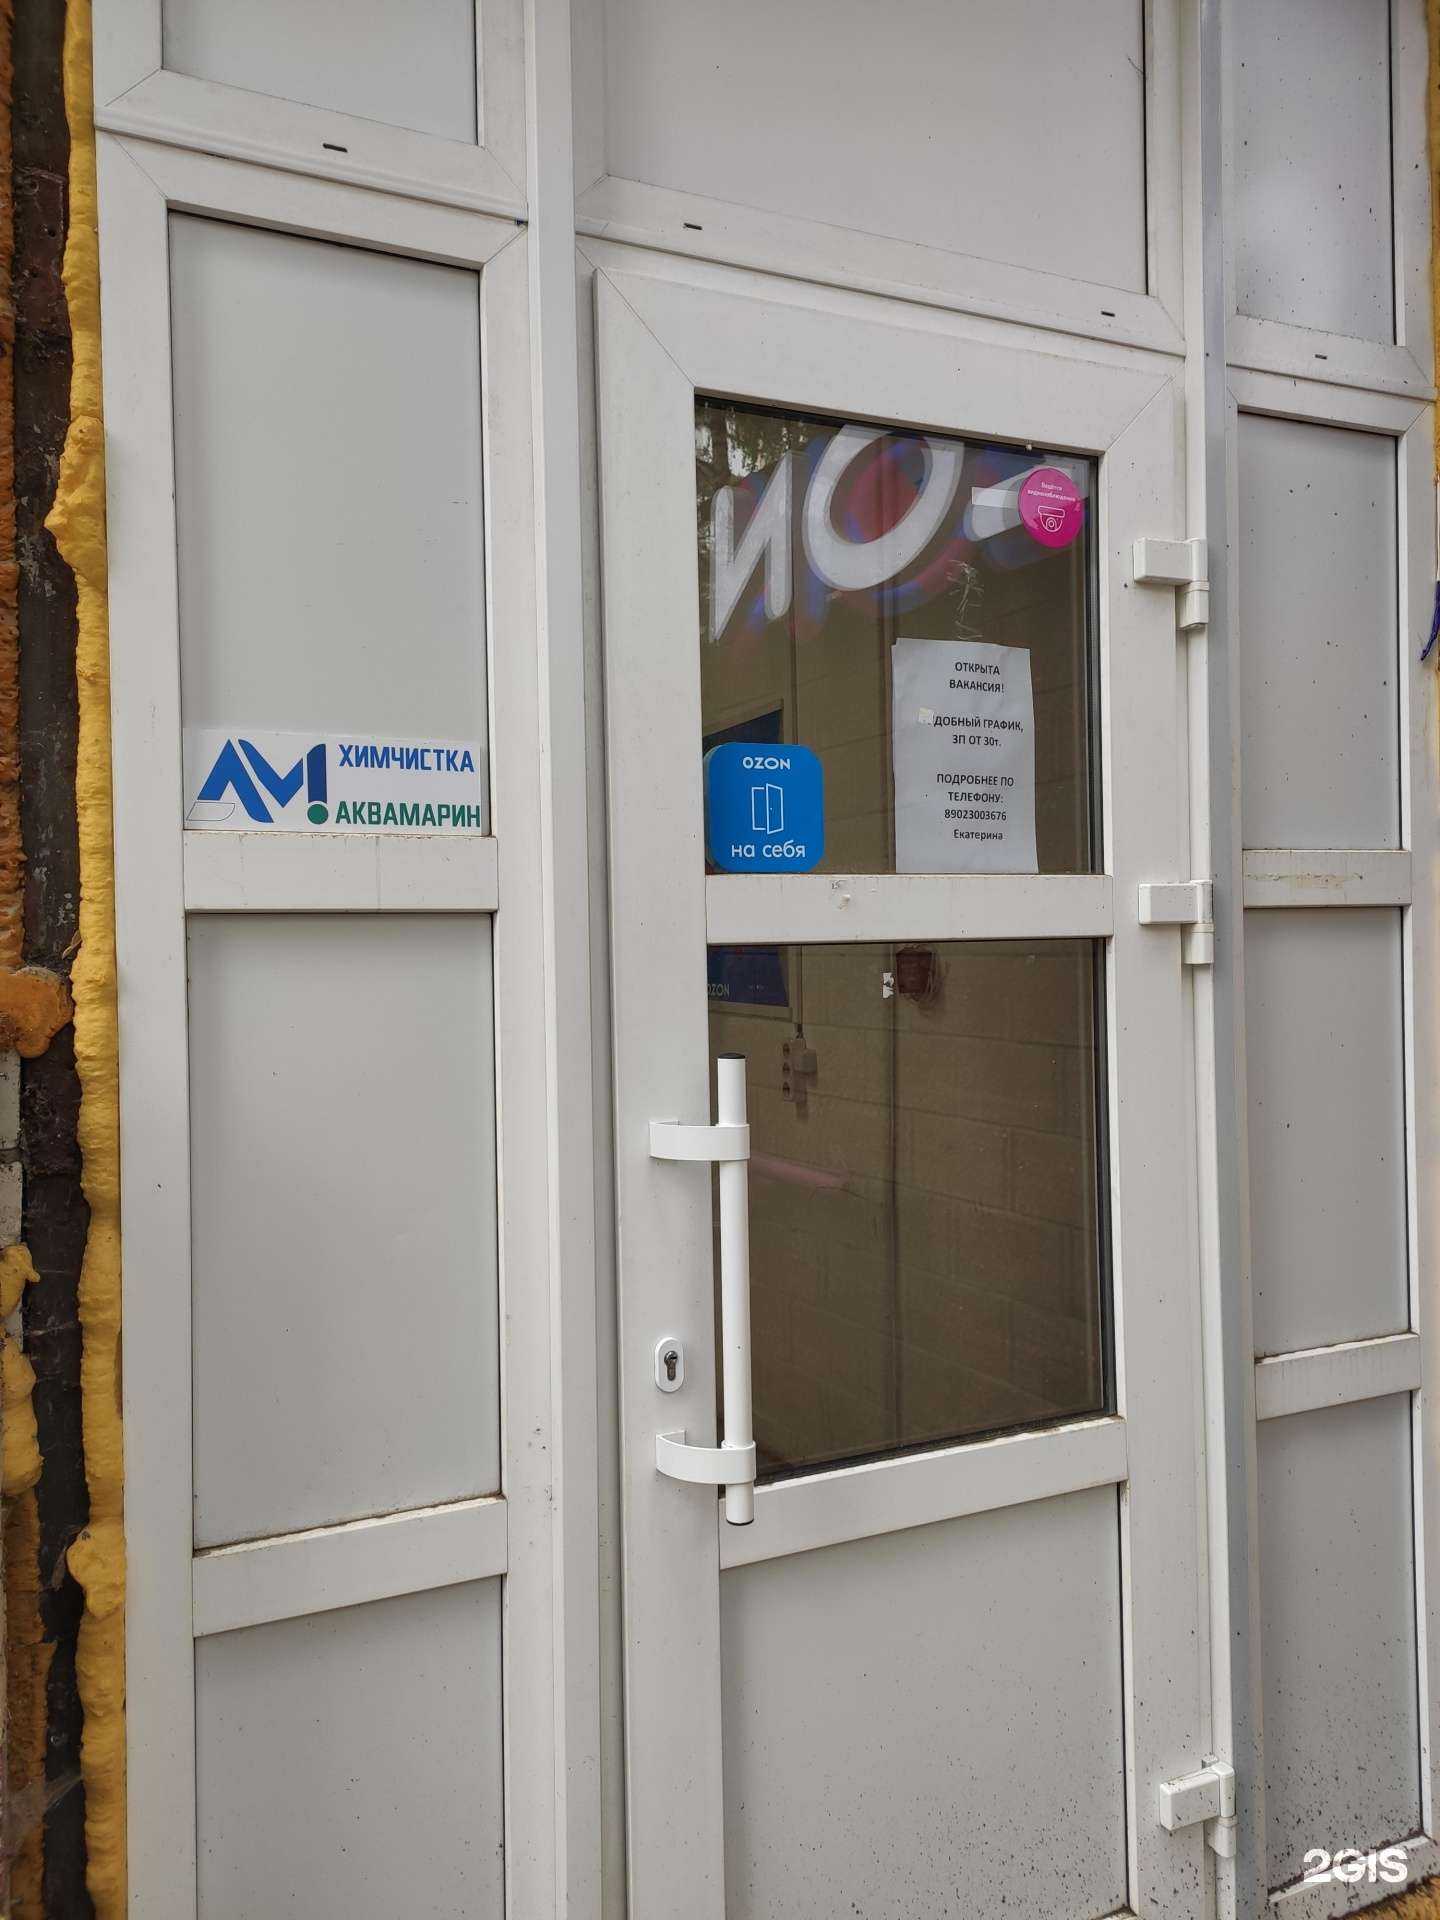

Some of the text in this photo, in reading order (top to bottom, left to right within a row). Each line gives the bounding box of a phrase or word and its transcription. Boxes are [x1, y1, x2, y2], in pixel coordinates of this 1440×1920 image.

[955, 661, 1000, 676] ОТКРЫТА
[949, 679, 1004, 694] ВАКАНСИЯ!
[928, 714, 1024, 732] ДОБНЫЙ ГРАФИК,
[952, 734, 966, 745] ЗП
[968, 735, 981, 746] ОТ
[338, 744, 475, 773] ХИМЧИСТКА
[742, 756, 791, 770] OZON
[936, 773, 1014, 787] ПОДРОБНЕЕ ПО
[948, 791, 1004, 803] ТЕЛЕФОНУ:
[335, 801, 481, 828] АКВАМАРИН
[944, 809, 1007, 821] 89023003676
[953, 829, 1003, 842] Екатерина
[731, 839, 806, 858] на себя
